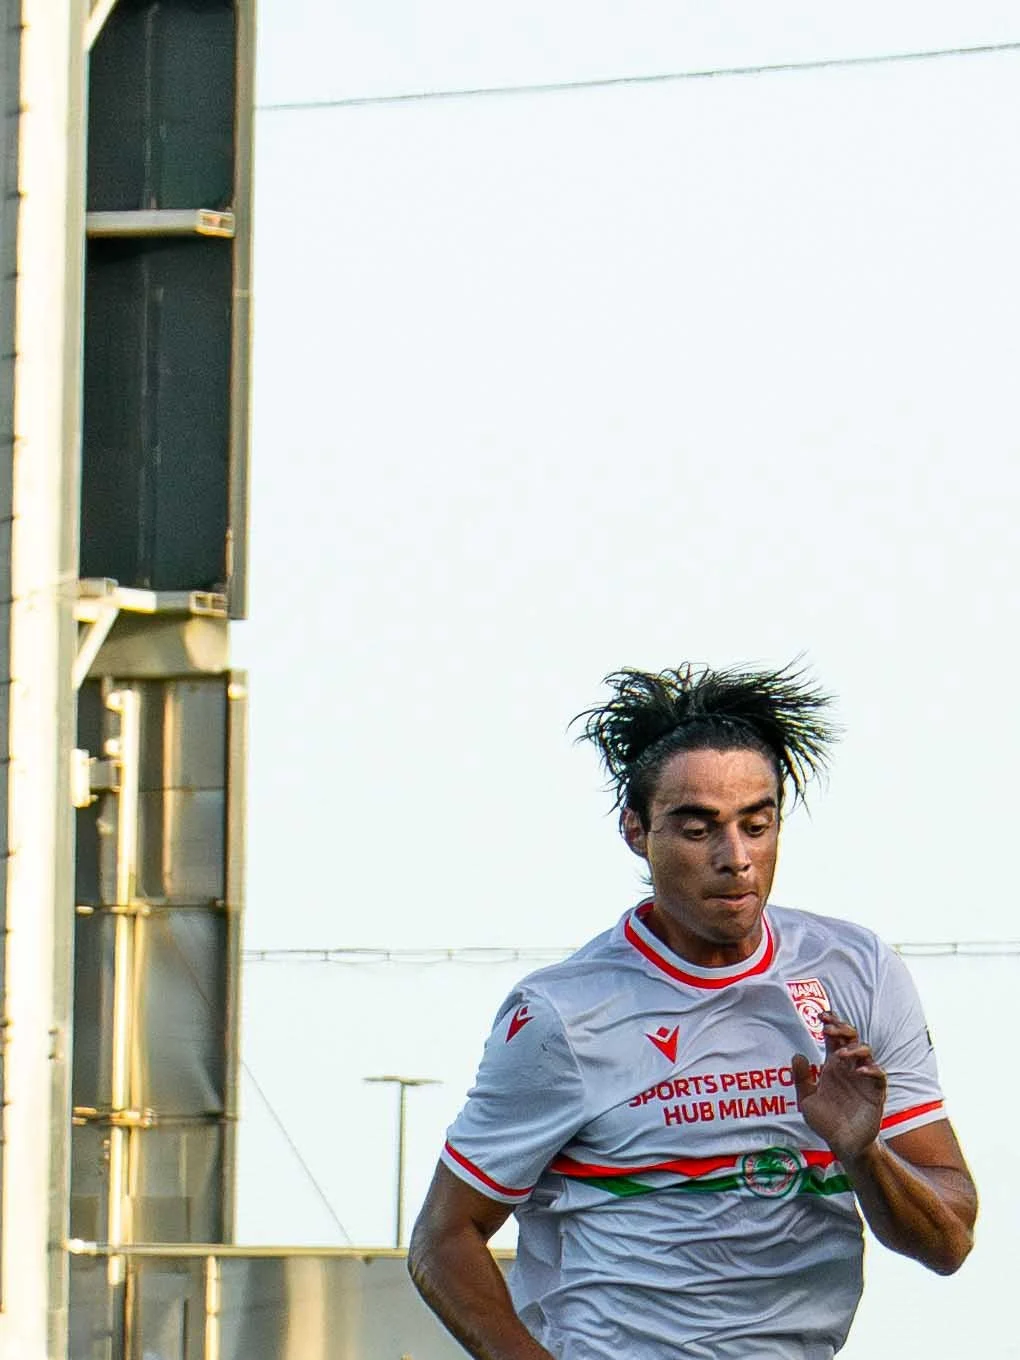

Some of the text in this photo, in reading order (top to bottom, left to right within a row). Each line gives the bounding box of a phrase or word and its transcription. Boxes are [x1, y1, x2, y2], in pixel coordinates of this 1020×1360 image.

[720, 1064, 822, 1092] PERFO
[664, 1095, 801, 1126] HUB MIAMI-
